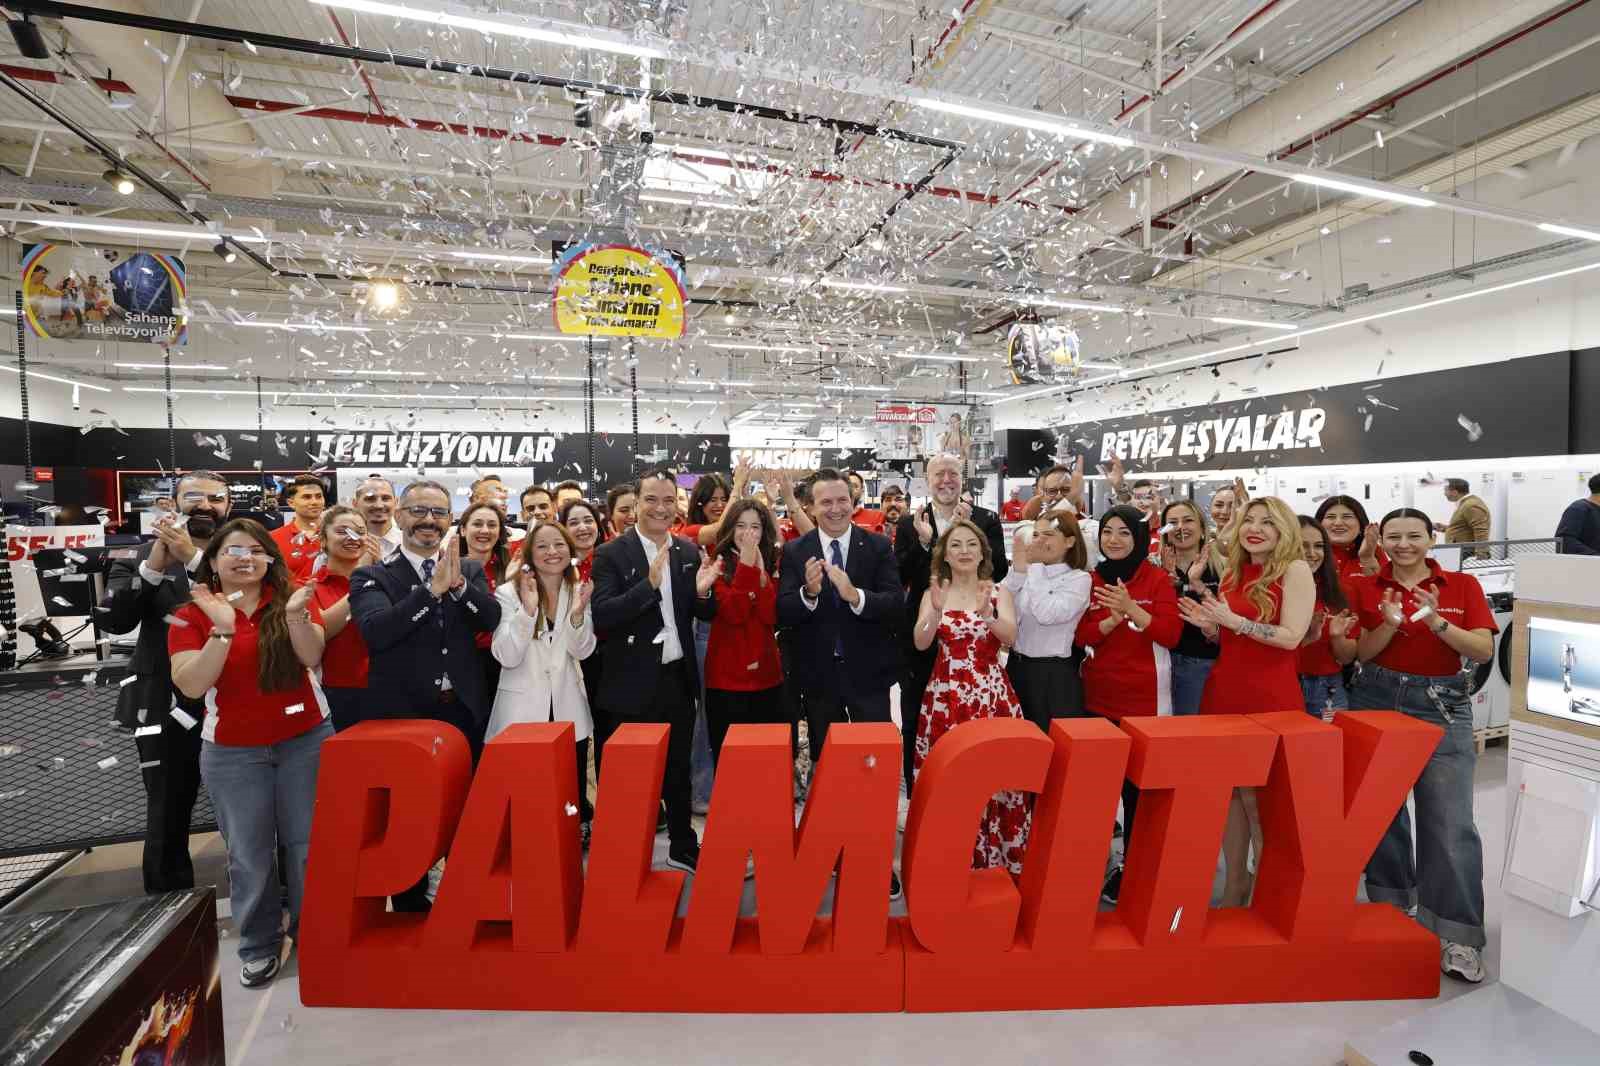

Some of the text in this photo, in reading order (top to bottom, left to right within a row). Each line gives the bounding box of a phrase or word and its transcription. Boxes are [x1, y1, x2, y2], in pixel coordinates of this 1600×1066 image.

[124, 311, 176, 325] Şahane
[316, 433, 556, 463] TELEVİZYONLAR
[1100, 408, 1326, 463] BEYAZ EŞYALAR
